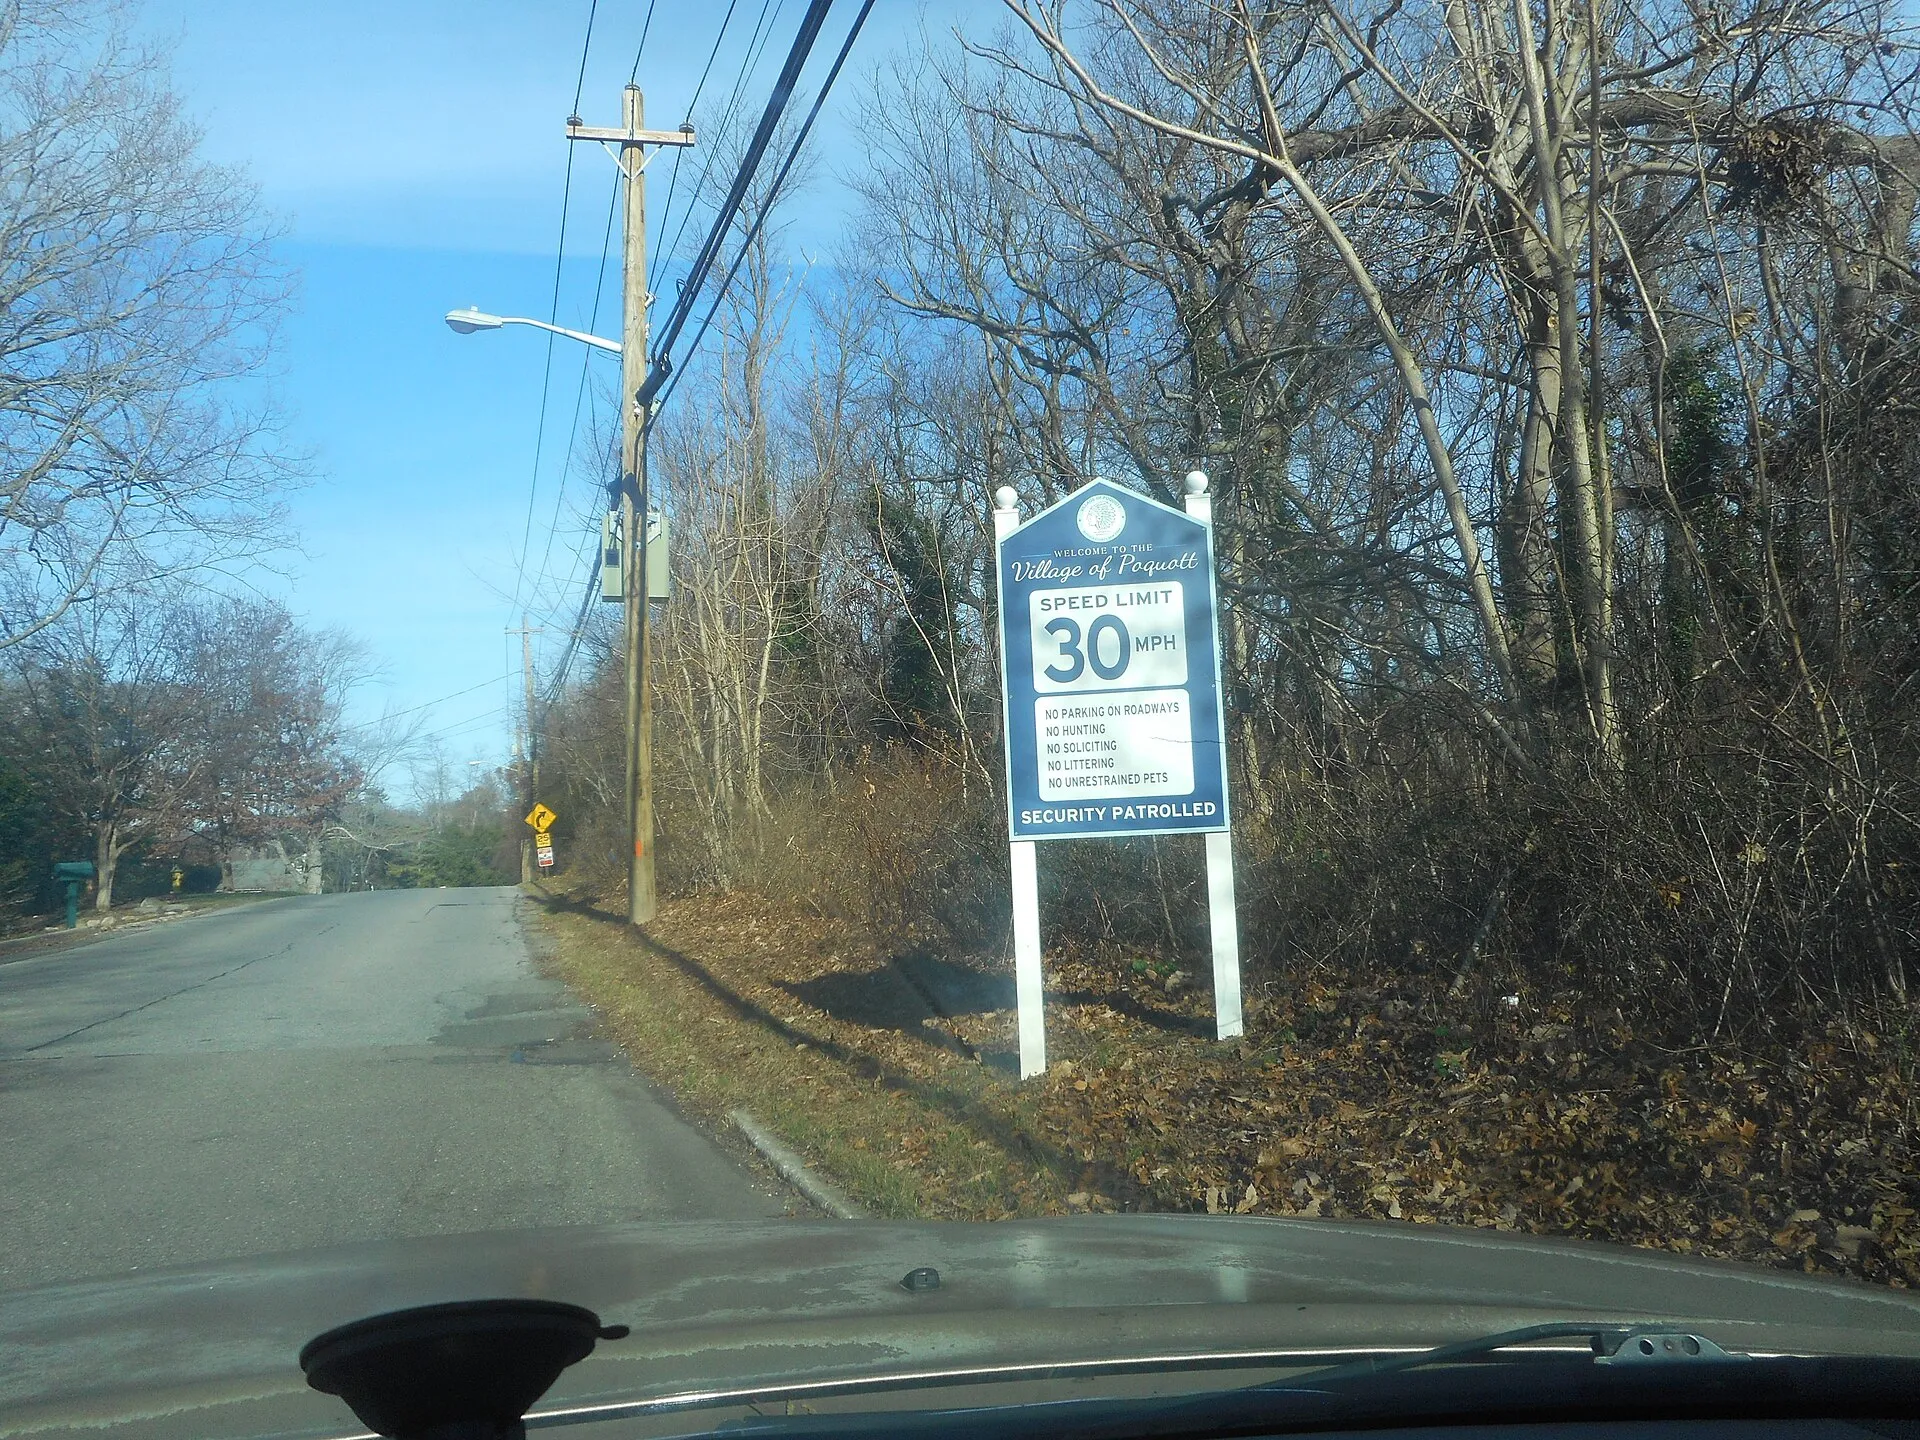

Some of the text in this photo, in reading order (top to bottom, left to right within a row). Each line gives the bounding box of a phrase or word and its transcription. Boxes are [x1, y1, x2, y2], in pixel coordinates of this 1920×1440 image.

[1053, 543, 1153, 558] WELCOME TO THE
[1011, 552, 1199, 583] Village of Poquott
[1040, 590, 1172, 611] SPEED LIMIT
[1043, 614, 1176, 684] 30 MPH
[1045, 702, 1180, 720] NO PARKING ON ROADWAYS
[1046, 723, 1106, 737] NO HUNTING
[1047, 740, 1117, 754] NO SOLICITING
[1047, 757, 1115, 771] NO LITTERING
[1048, 773, 1168, 789] NO UNRESTRAINED PETS
[1021, 801, 1216, 825] SECURITY PATROLLED
[537, 834, 549, 842] 25
